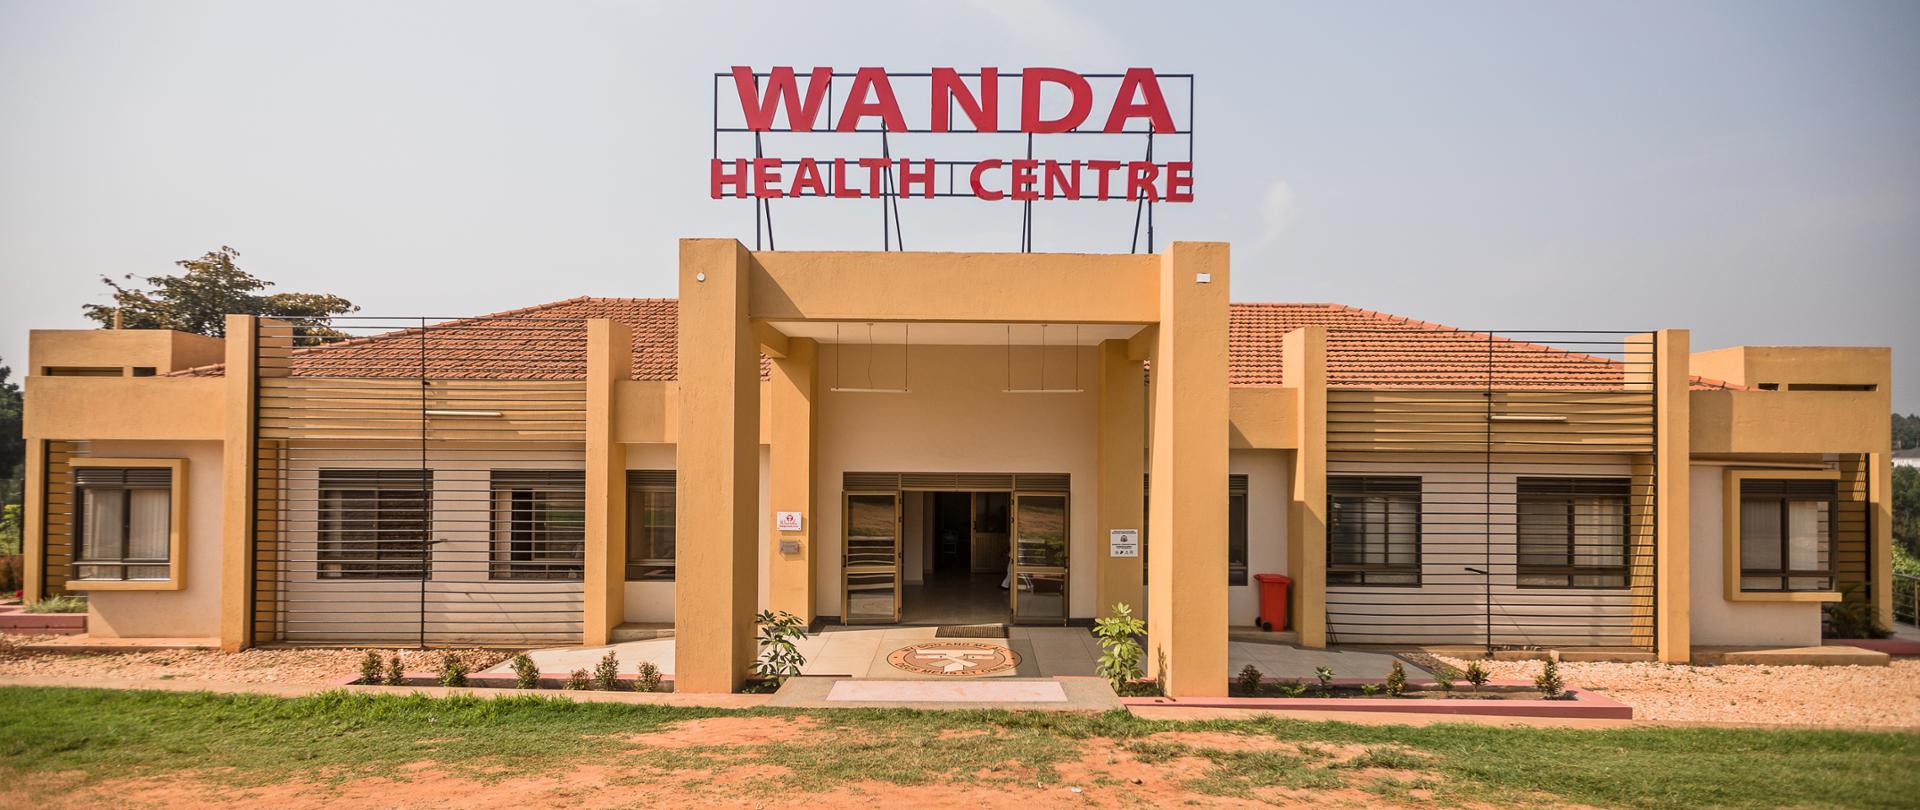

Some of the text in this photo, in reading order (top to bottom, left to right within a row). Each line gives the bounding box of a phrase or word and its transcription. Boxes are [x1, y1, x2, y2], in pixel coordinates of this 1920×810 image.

[731, 66, 1177, 133] WANDA
[711, 158, 1194, 203] HEALTH CENTRE
